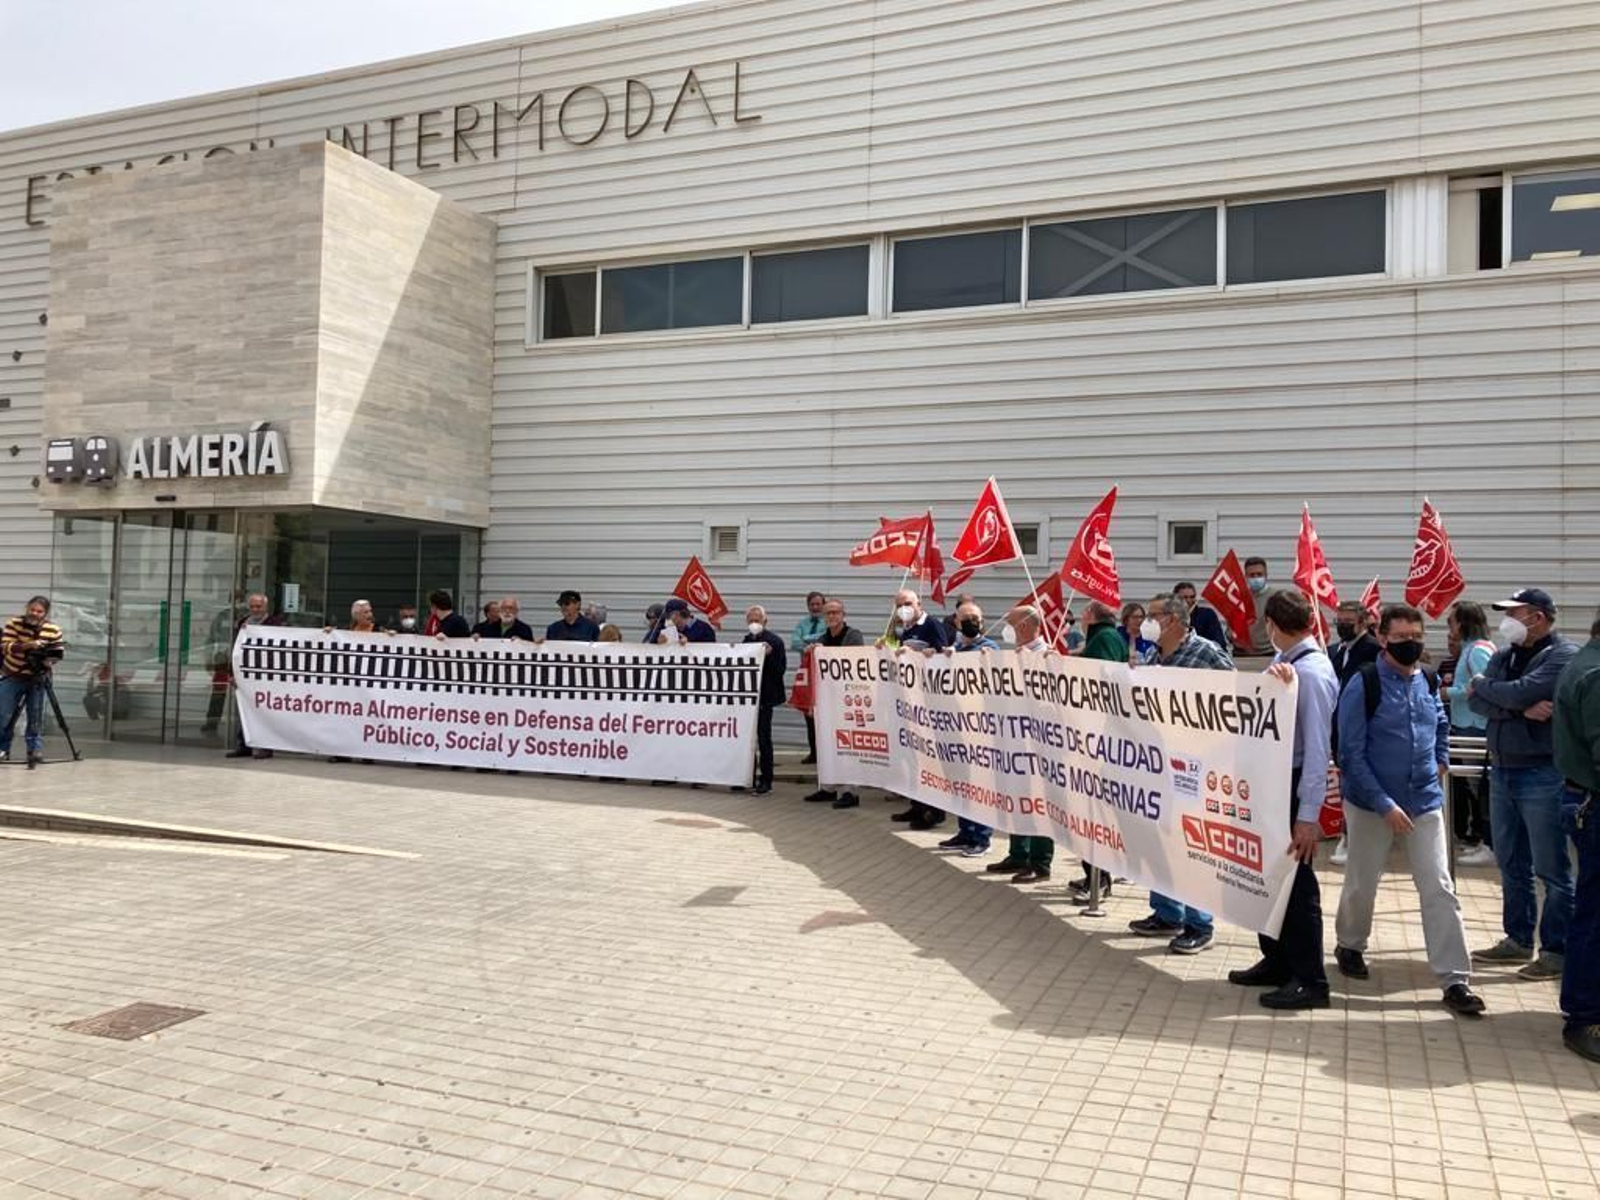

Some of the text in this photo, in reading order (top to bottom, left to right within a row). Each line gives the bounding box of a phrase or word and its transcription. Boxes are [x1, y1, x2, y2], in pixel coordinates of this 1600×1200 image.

[326, 61, 763, 171] NTERMODAL
[126, 420, 285, 479] ALMERÍA
[254, 691, 739, 739] Plataforma Almeriense en Defensa del Ferrocarril
[818, 658, 853, 681] POR
[857, 658, 876, 681] EL
[928, 667, 991, 696] MEJORA
[992, 667, 1023, 697] DEL
[1023, 668, 1130, 718] FERROCARRIL
[1131, 685, 1165, 724] EN
[1169, 686, 1281, 742] ALMERÍA
[363, 724, 629, 760] Público, Social y Sostenible
[928, 709, 996, 736] SERVICIOS
[999, 713, 1006, 738] Y
[1007, 715, 1064, 749] TRENES
[1066, 725, 1085, 756] DE
[1085, 732, 1164, 775] CALIDAD
[920, 769, 952, 795] SECTOR
[953, 779, 1015, 813] FERROVIARIO
[1019, 796, 1046, 816] DE
[1070, 814, 1126, 853] ALMERÍA
[935, 742, 1067, 788] INFRAESTRUCTURAS
[1069, 767, 1162, 821] MODERNAS
[1208, 827, 1260, 864] CCOO
